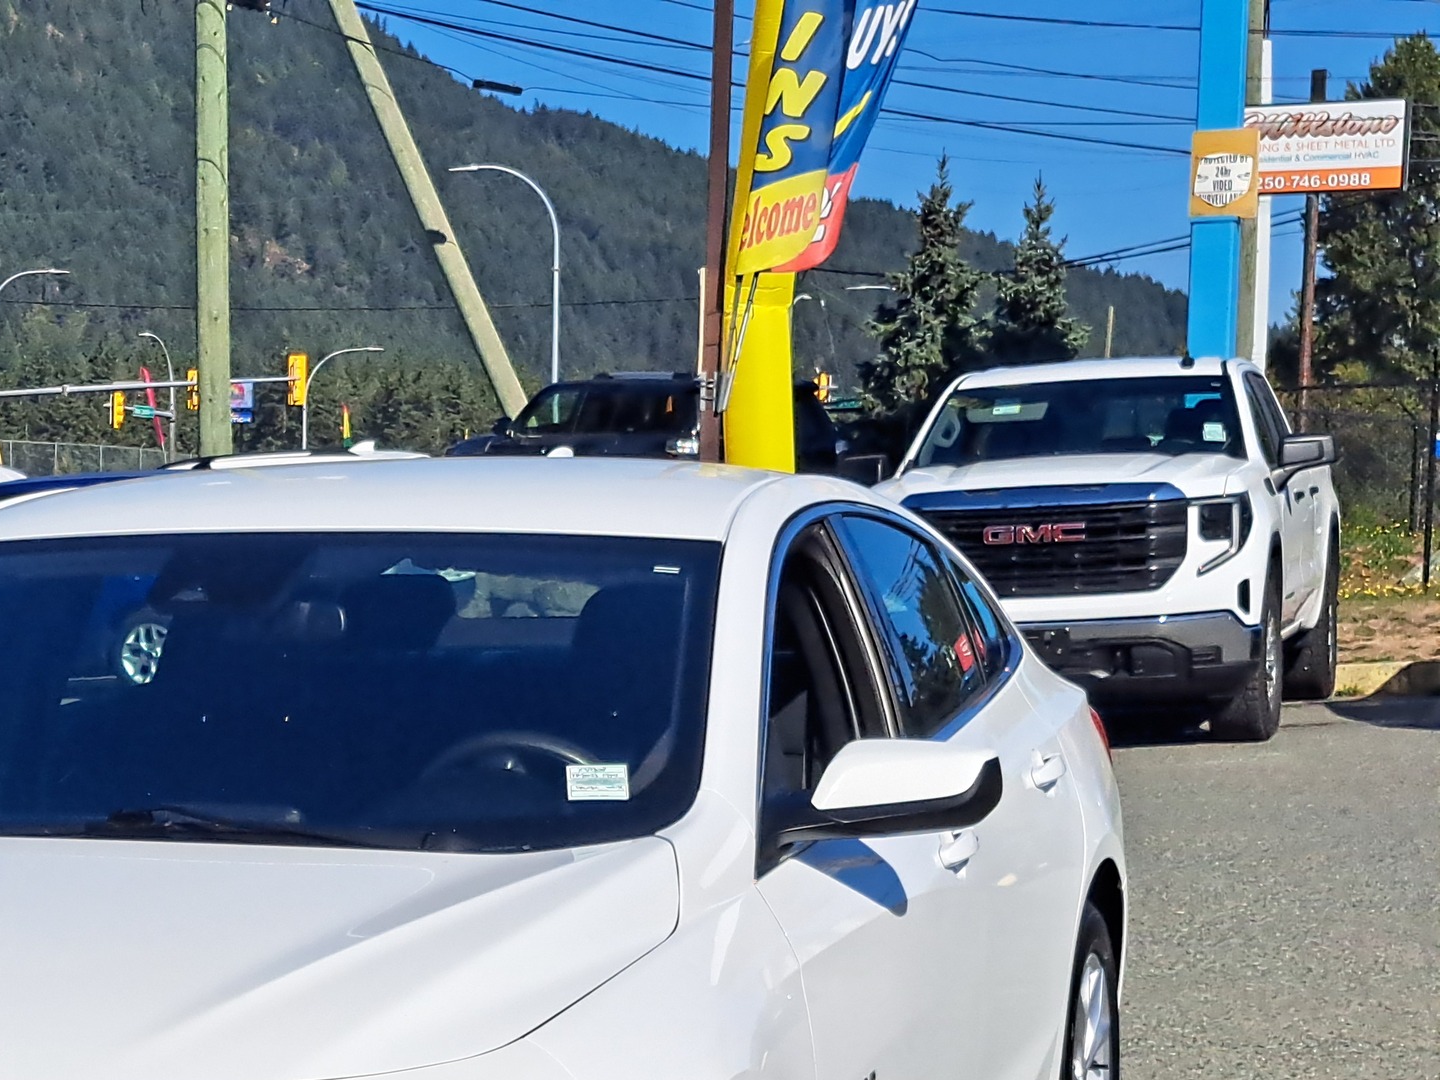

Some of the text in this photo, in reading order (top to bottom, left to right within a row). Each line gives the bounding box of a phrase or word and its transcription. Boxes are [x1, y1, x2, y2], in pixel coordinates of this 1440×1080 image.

[1259, 144, 1280, 152] ING
[1296, 141, 1329, 151] SHEET
[1334, 139, 1370, 149] METAL
[1212, 179, 1233, 192] VIDEO
[1258, 172, 1371, 190] 250-746-0988
[739, 192, 817, 252] elcome
[983, 522, 1087, 546] GMC
